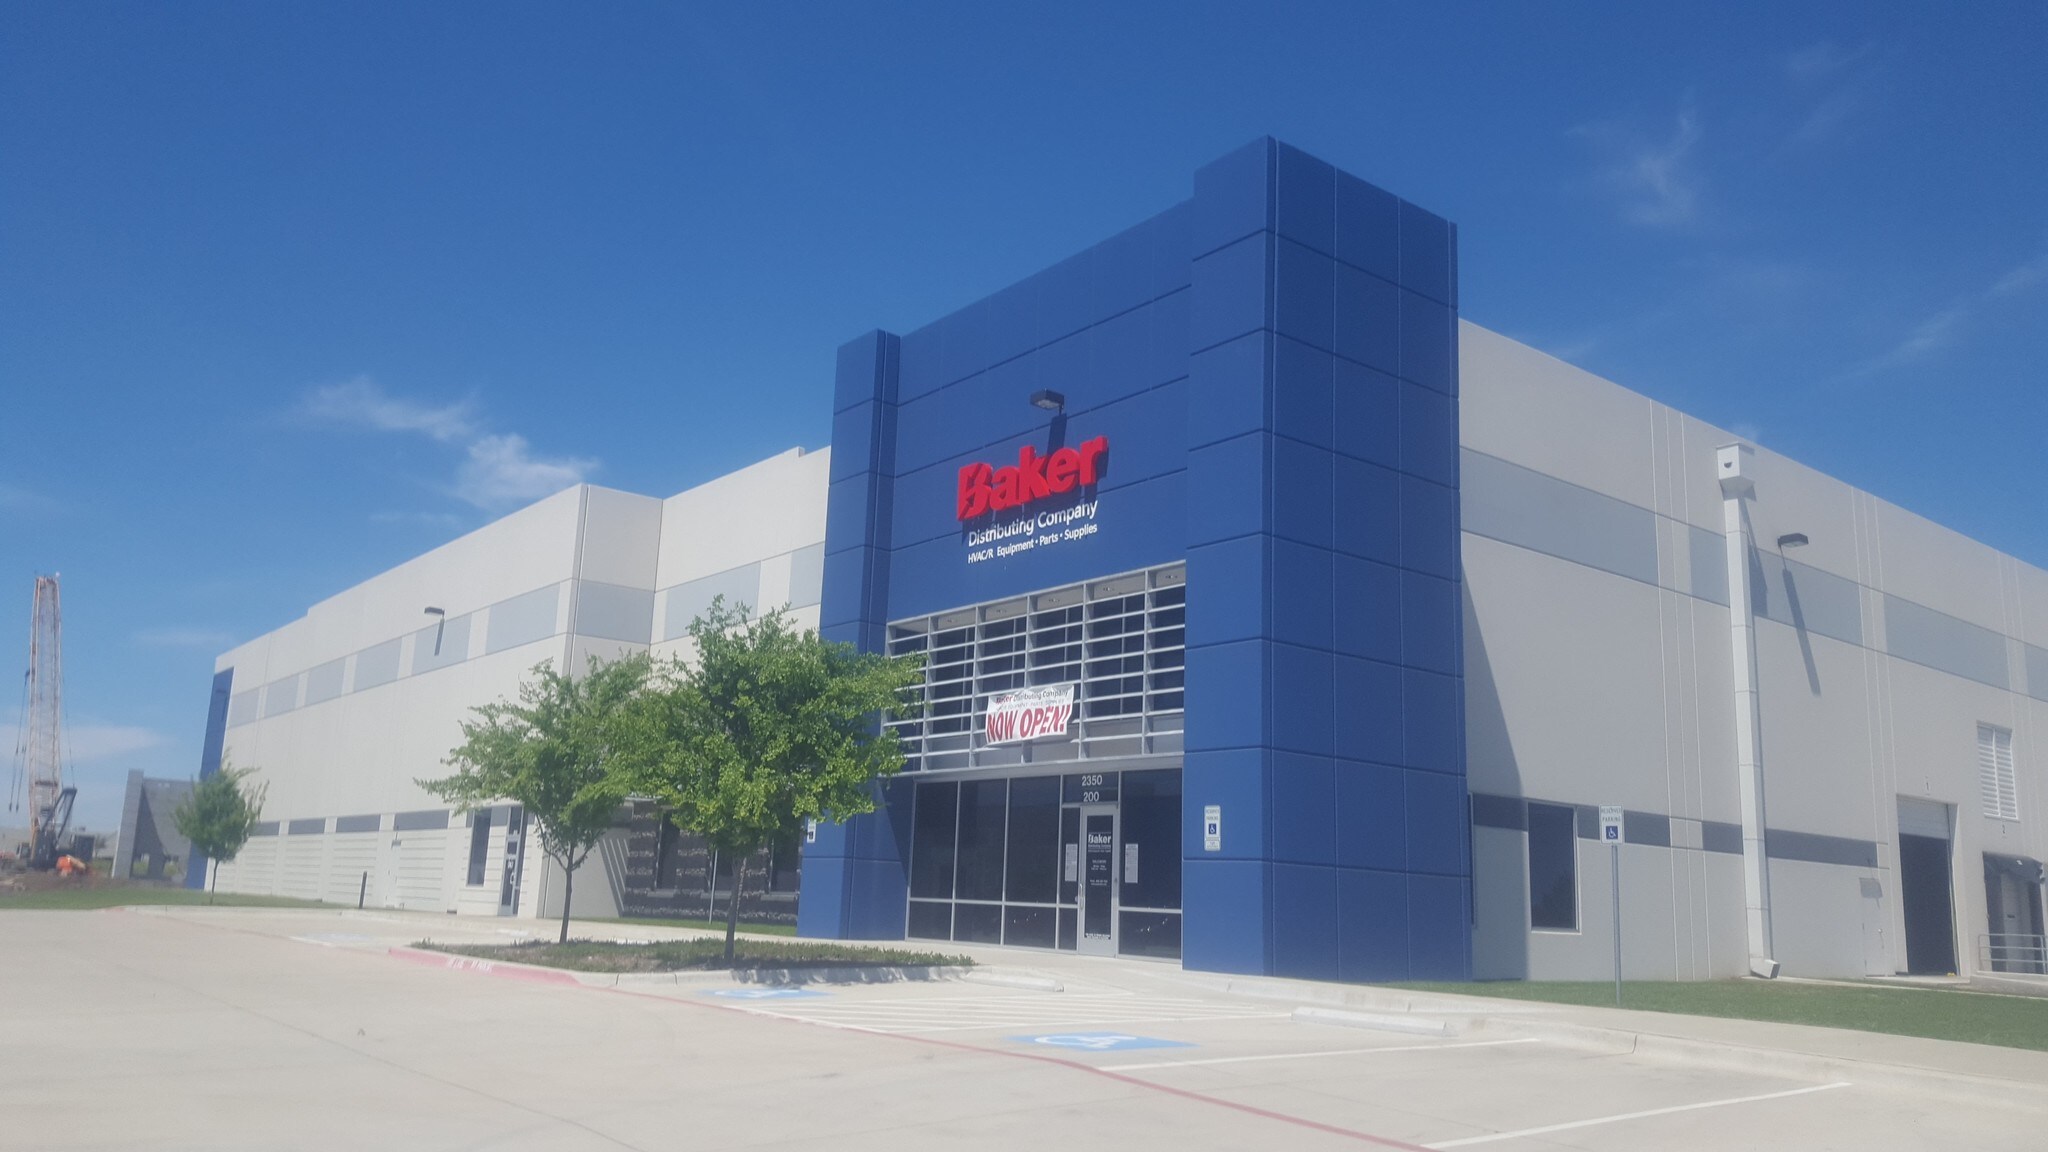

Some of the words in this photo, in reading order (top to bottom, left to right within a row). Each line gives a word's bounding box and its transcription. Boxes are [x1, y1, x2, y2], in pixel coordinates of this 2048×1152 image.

[957, 435, 1108, 521] Baker
[968, 519, 1034, 547] Distributing
[1037, 500, 1098, 528] Company
[968, 548, 994, 563] HVAC/R
[997, 538, 1034, 557] Equipment
[1039, 531, 1059, 546] Parts
[1064, 523, 1098, 541] Supplies
[987, 710, 1018, 743] NOW
[1020, 704, 1071, 738] OPEN!
[1081, 774, 1103, 786] 2350
[1083, 791, 1100, 802] 200
[1088, 833, 1111, 844] Baker
